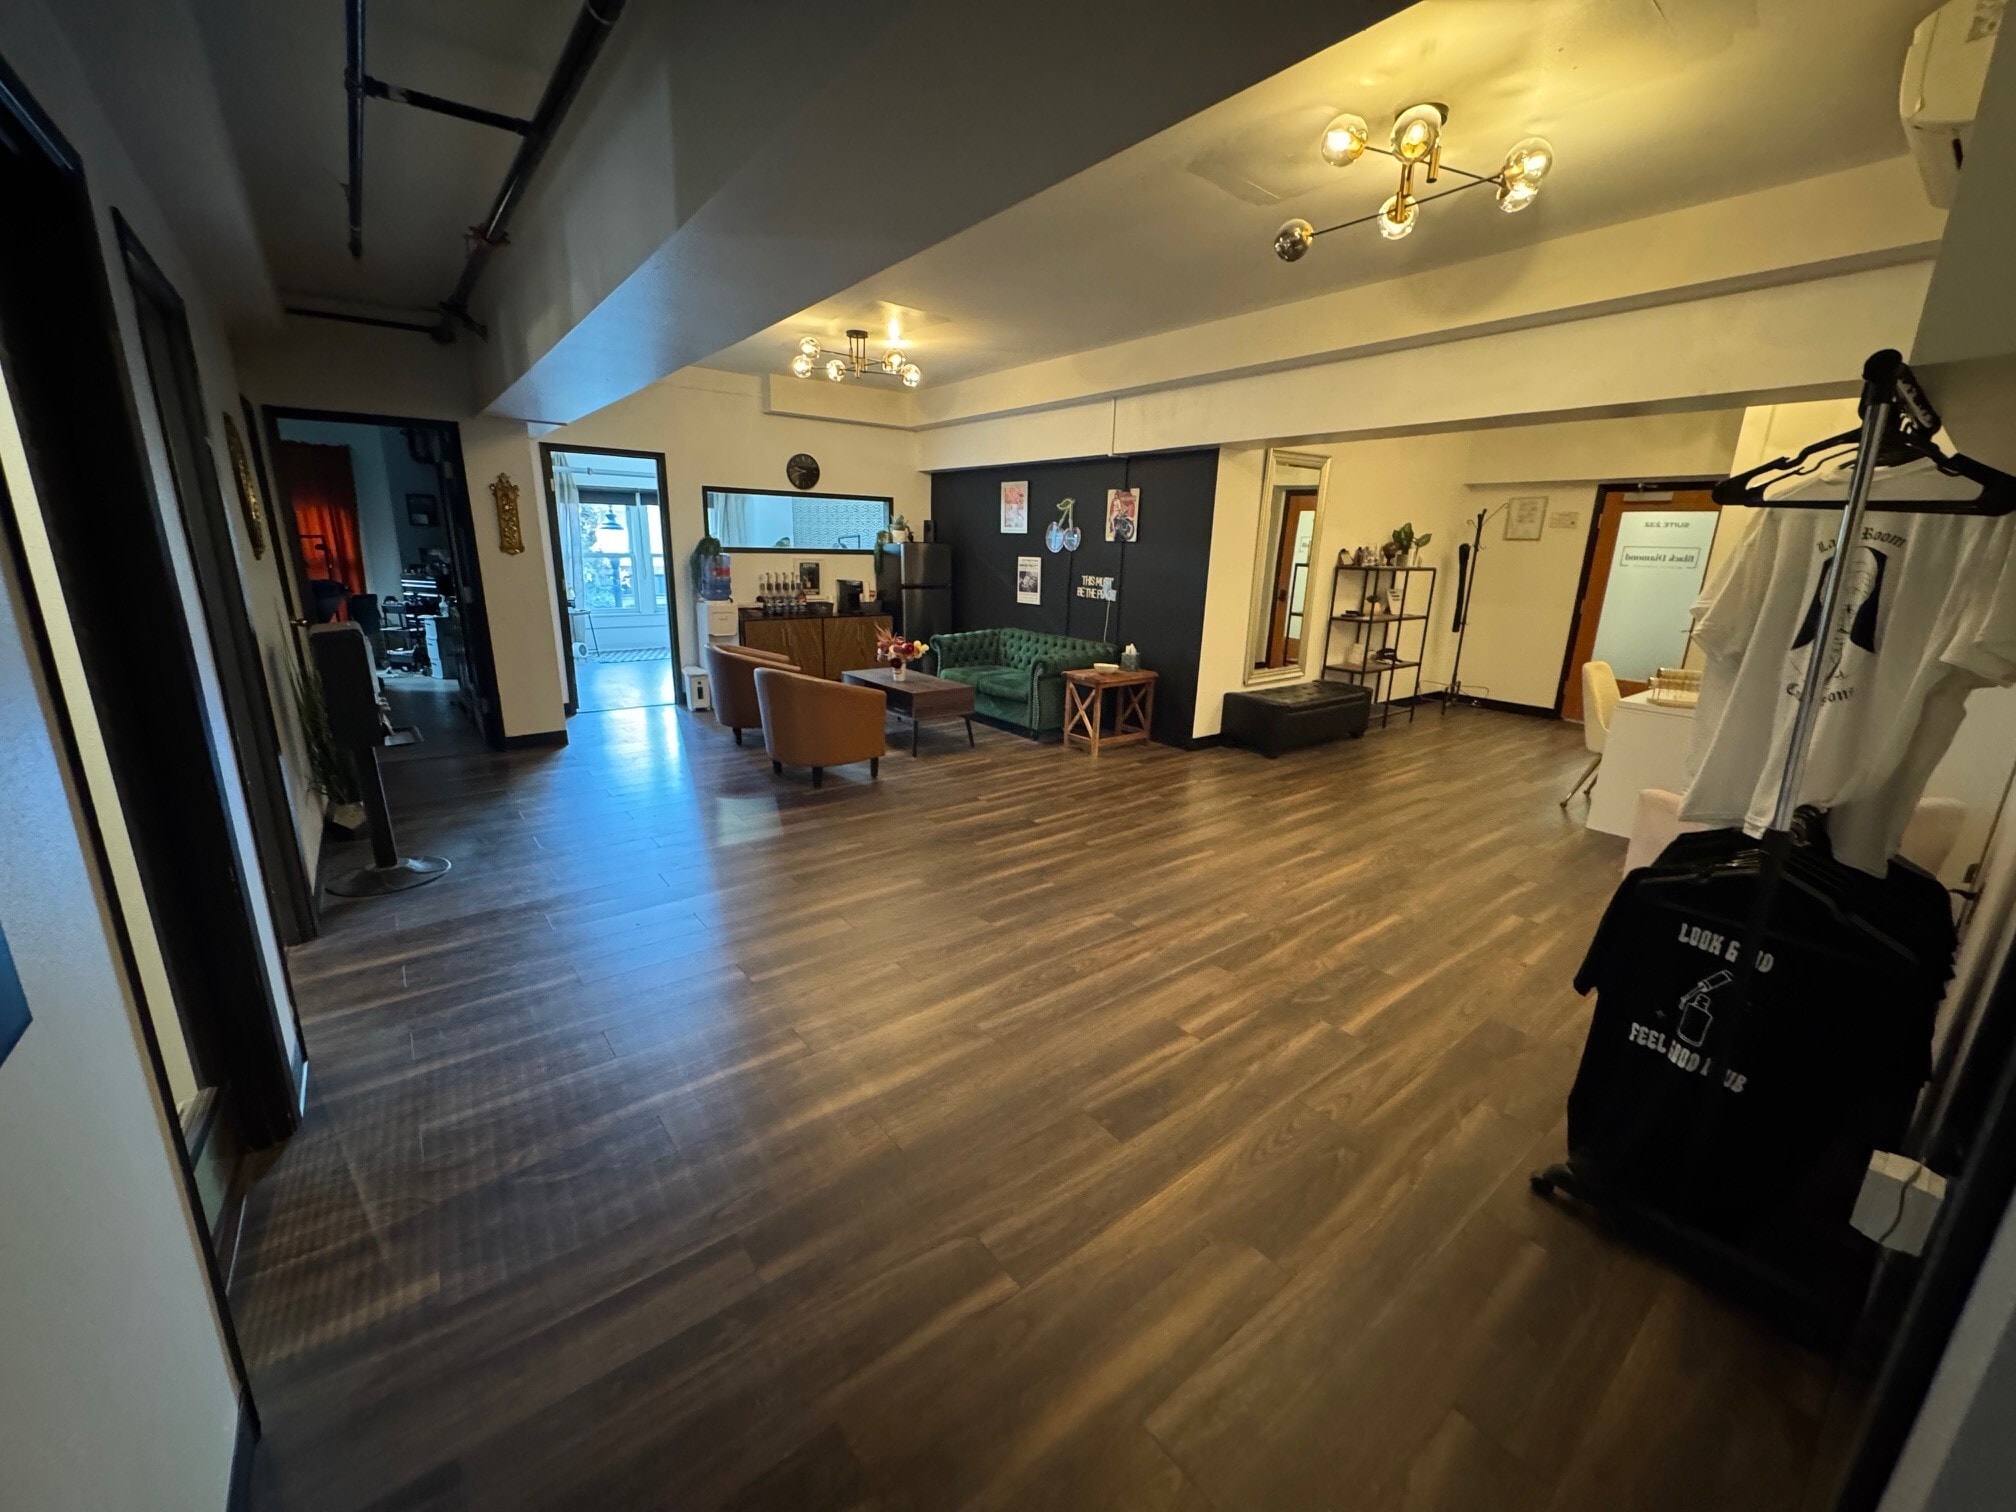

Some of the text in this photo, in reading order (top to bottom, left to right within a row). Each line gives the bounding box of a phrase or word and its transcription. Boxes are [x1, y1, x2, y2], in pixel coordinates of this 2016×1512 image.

[1860, 526, 1907, 548] Room
[1081, 575, 1115, 587] THIS MUST
[1076, 586, 1086, 598] BE
[1085, 587, 1097, 599] THE
[1678, 922, 1774, 973] LOOK GD
[1628, 1022, 1667, 1054] FEEL
